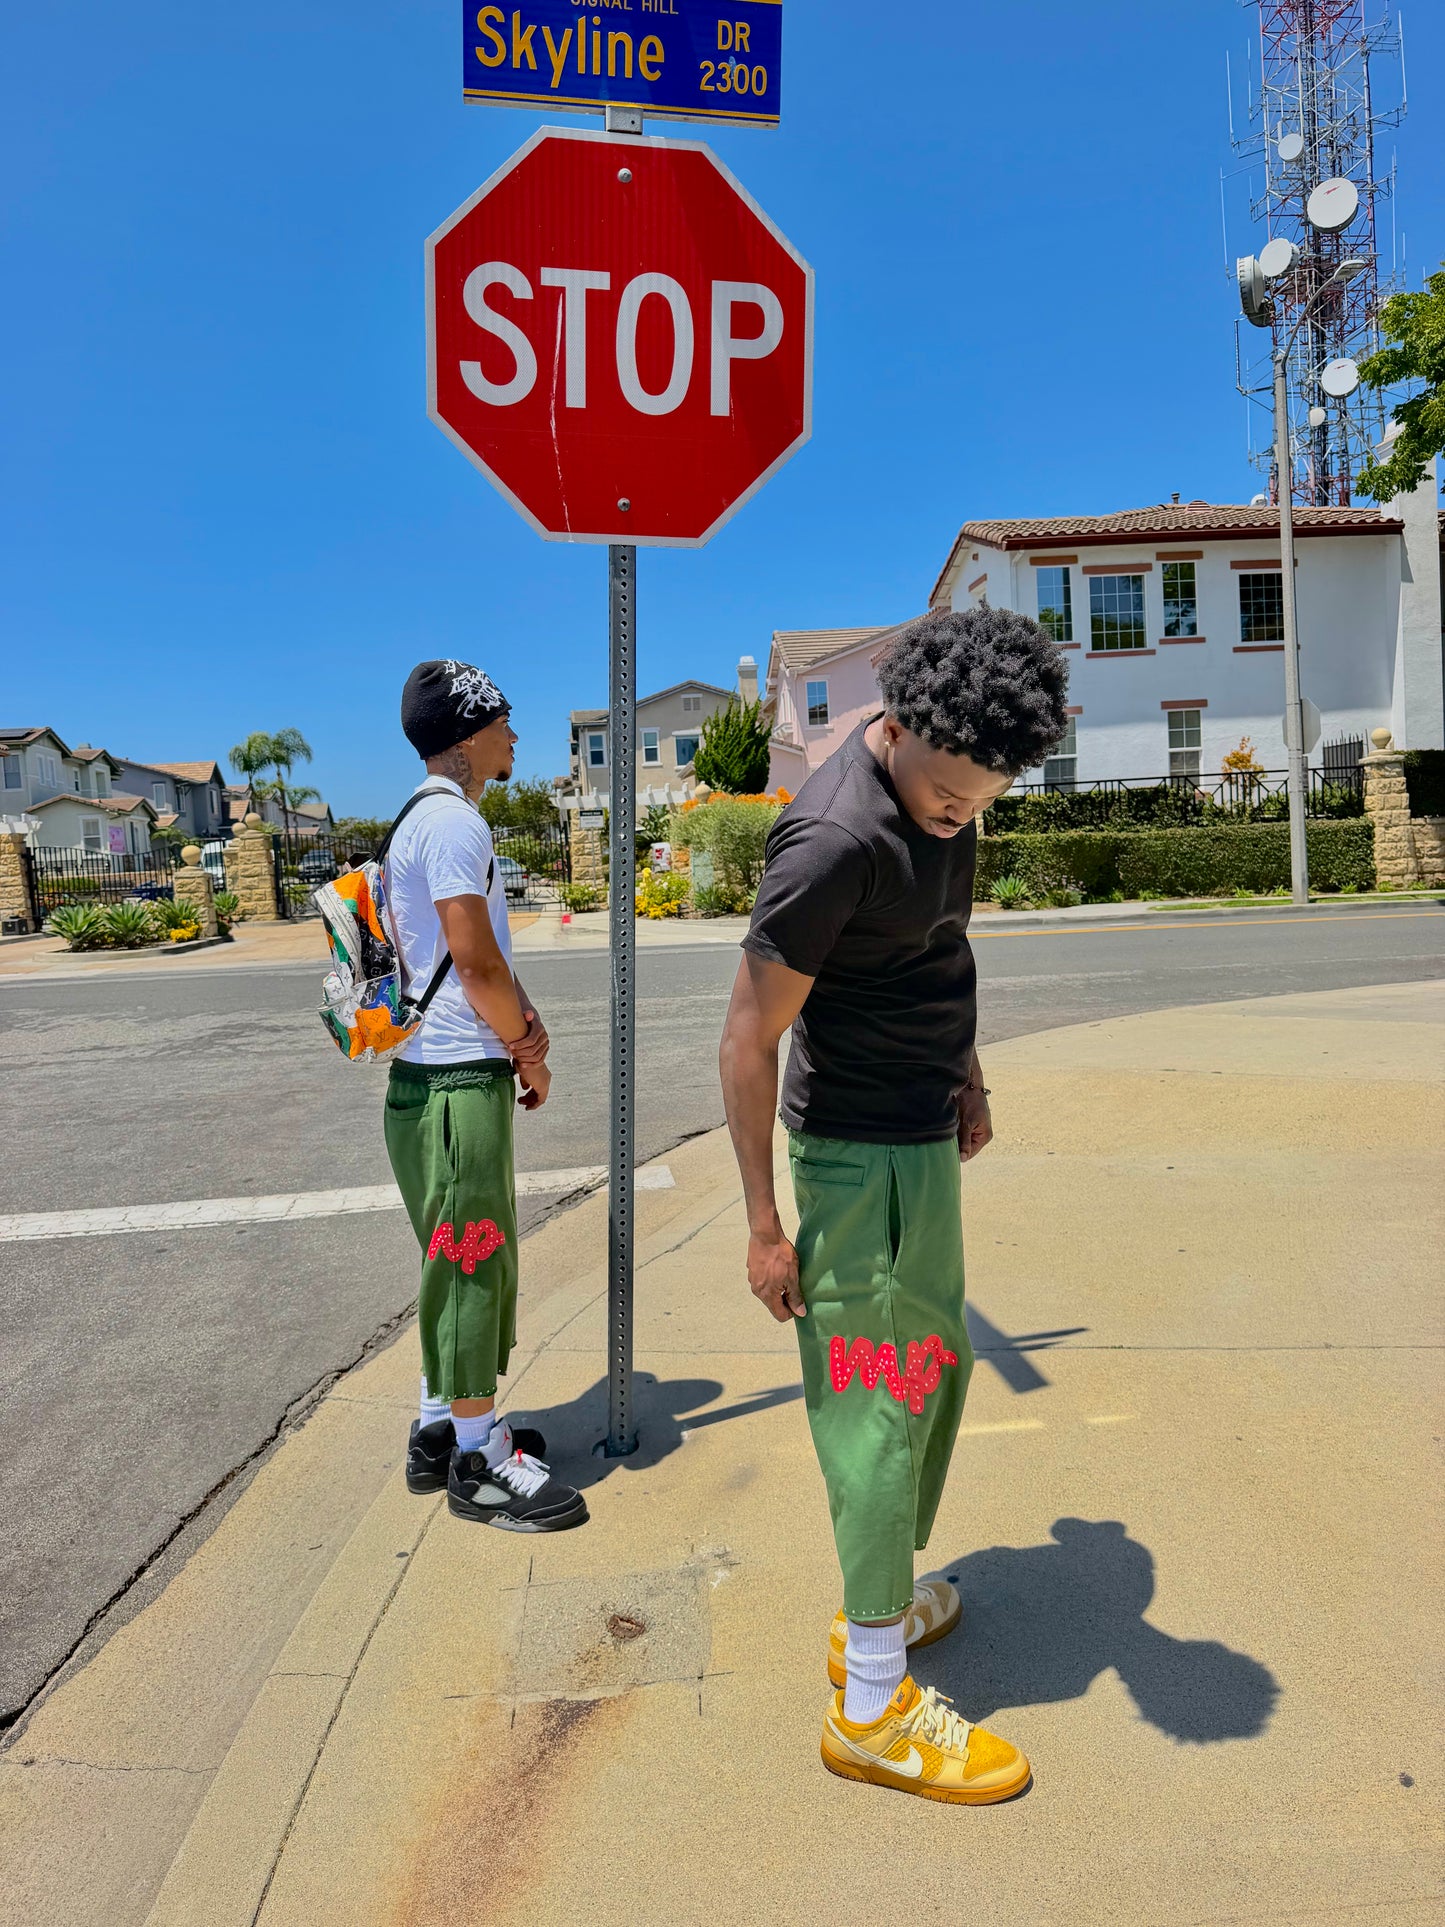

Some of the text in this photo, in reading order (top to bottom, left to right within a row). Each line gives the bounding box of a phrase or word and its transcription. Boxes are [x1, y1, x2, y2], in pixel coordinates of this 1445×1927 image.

[642, 0, 679, 15] HILL
[475, 5, 751, 89] Skyline DR
[699, 60, 768, 96] 2300
[459, 261, 784, 417] STOP
